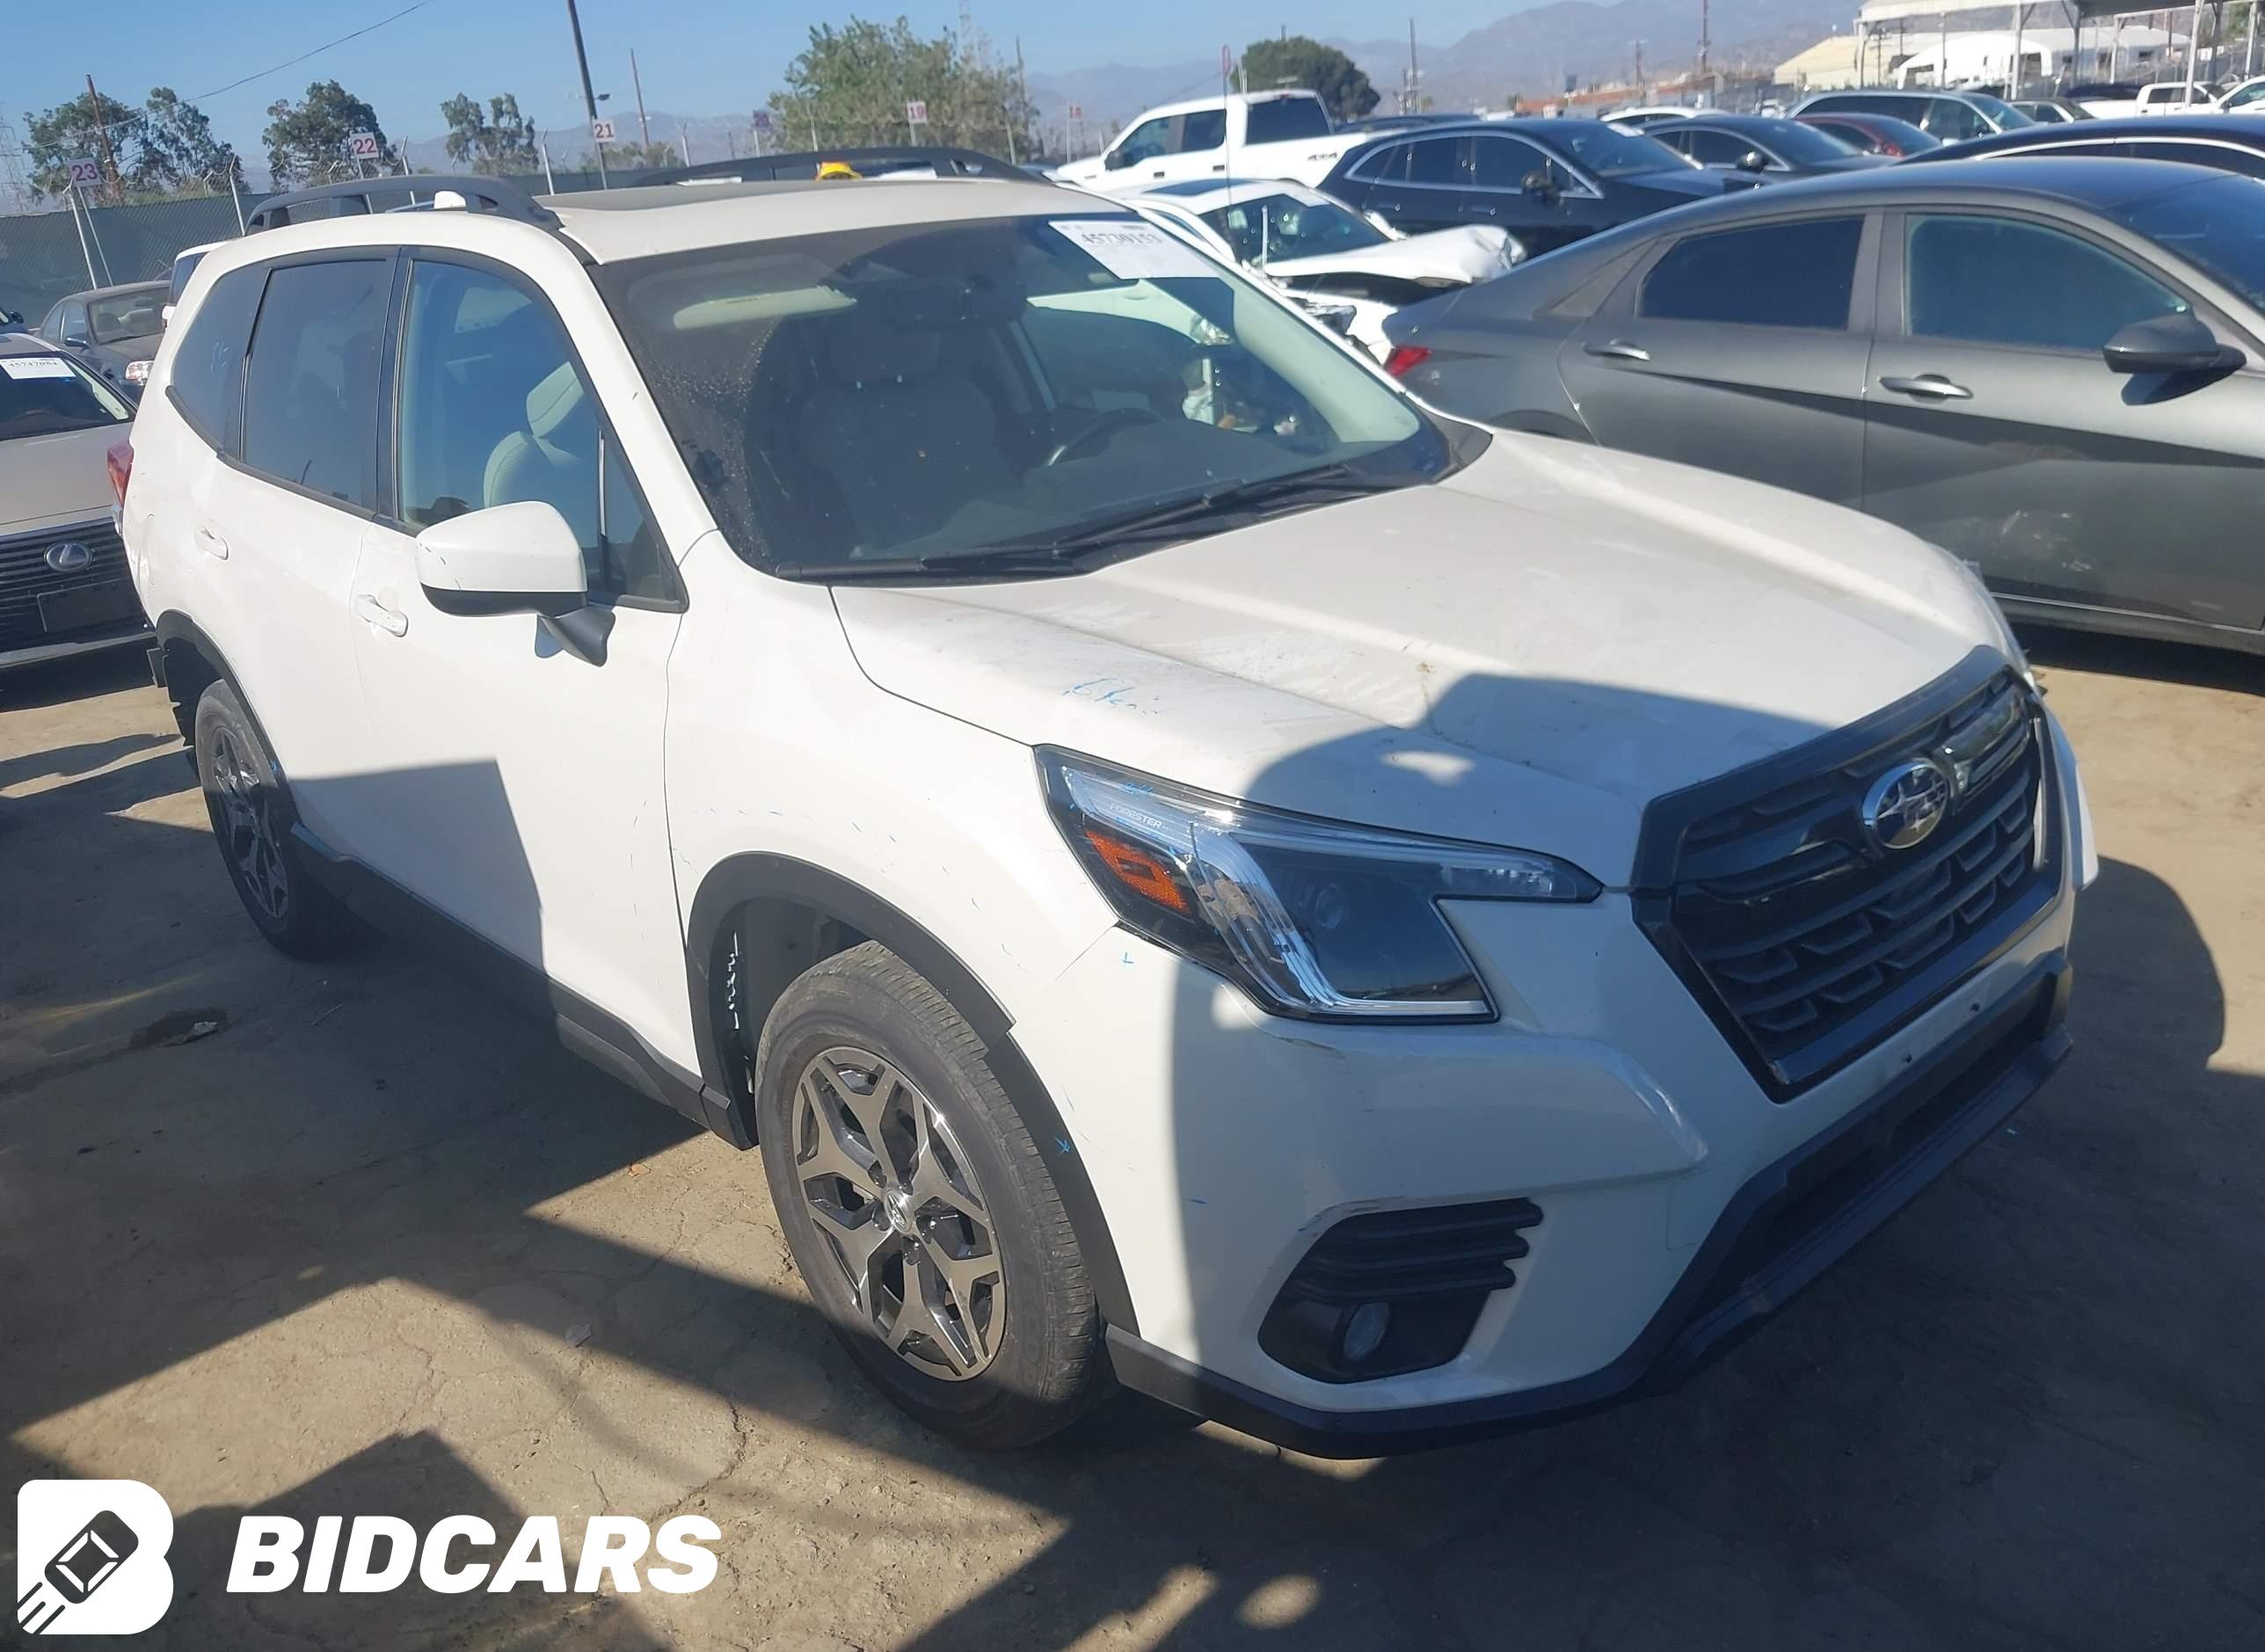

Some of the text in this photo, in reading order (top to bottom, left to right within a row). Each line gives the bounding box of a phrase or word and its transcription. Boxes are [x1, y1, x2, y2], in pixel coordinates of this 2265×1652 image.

[594, 123, 615, 139] 21
[353, 138, 377, 155] 22
[72, 164, 98, 182] 23
[1109, 802, 1162, 829] FORESTER
